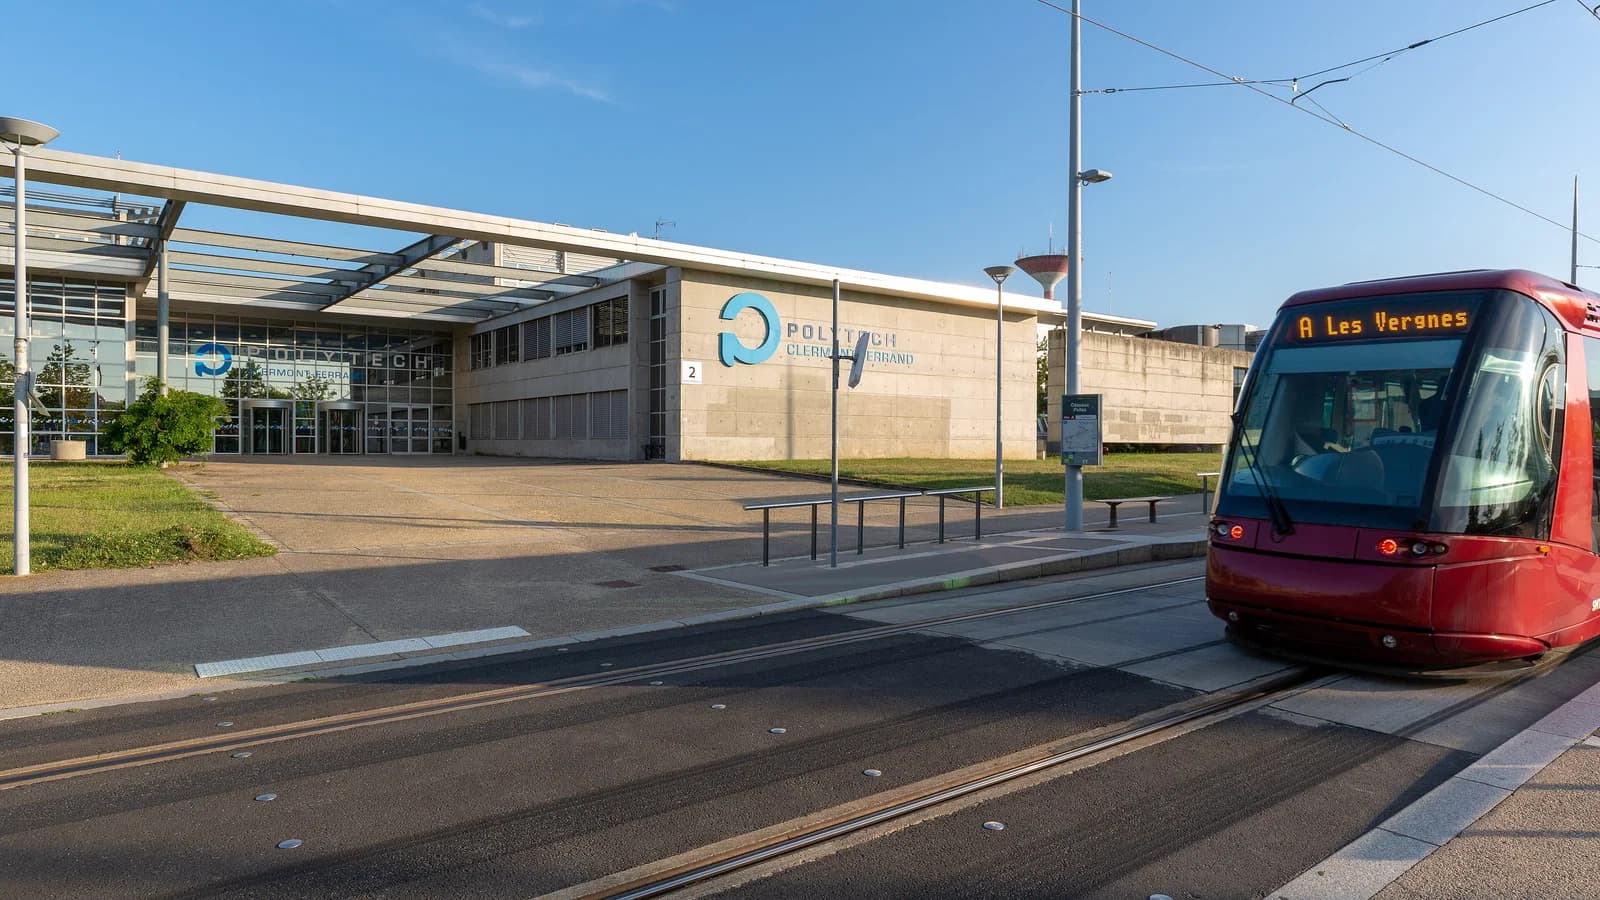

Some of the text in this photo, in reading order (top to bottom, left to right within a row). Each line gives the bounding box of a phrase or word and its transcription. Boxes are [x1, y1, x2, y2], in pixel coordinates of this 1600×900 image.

[1300, 311, 1467, 338] A Les Vergnes
[247, 346, 427, 369] POLYTECH
[689, 366, 696, 378] 2
